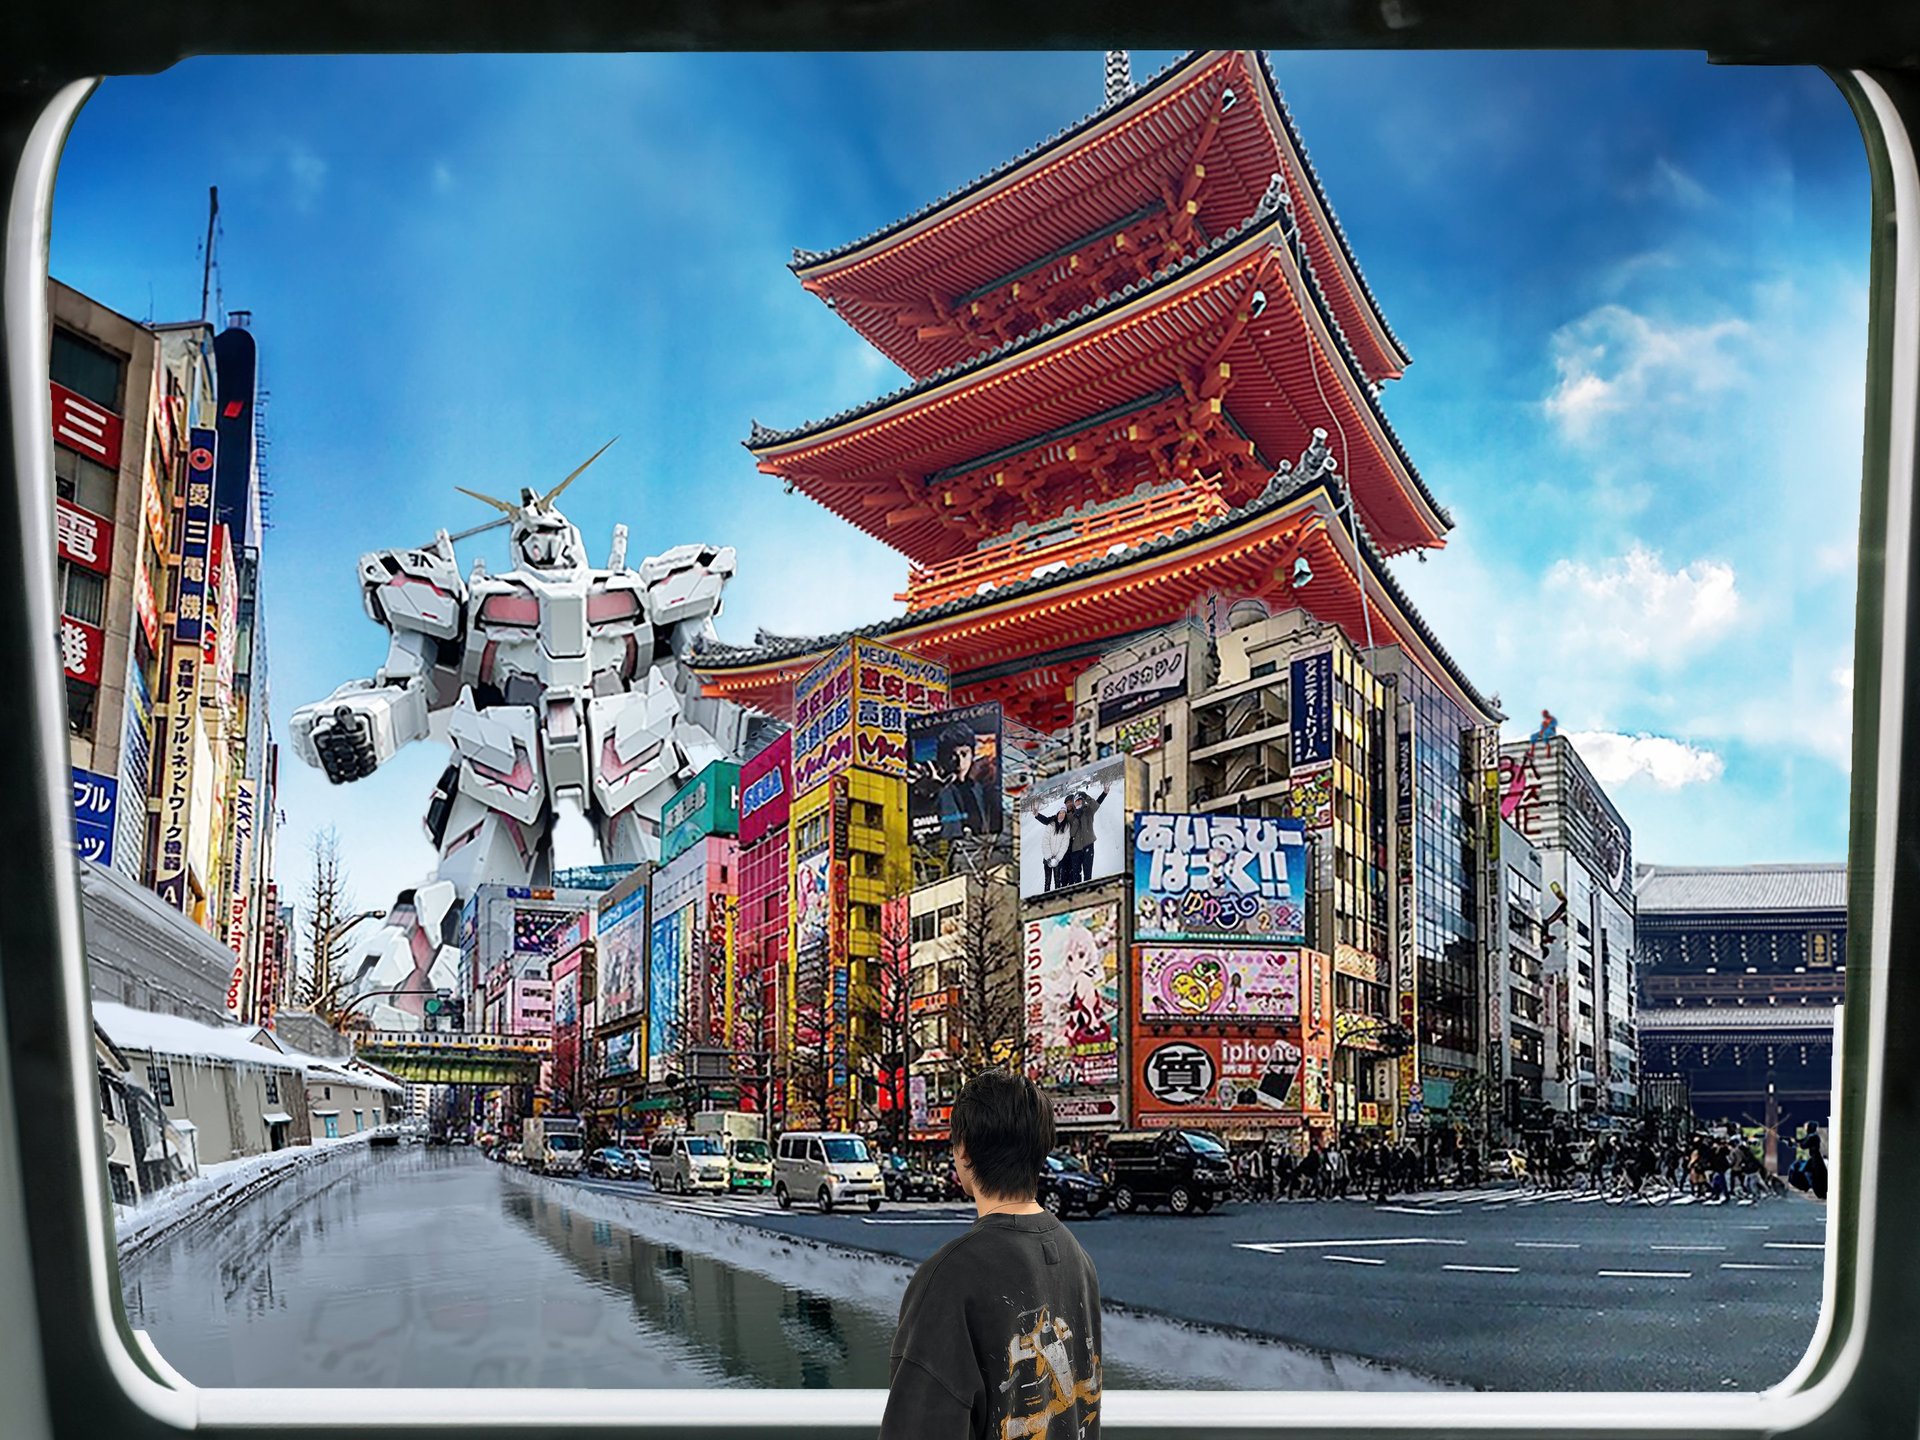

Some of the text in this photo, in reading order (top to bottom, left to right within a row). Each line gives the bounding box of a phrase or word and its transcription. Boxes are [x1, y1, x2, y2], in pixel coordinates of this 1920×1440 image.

[237, 784, 253, 840] AKKY
[742, 765, 785, 820] SEGA
[1136, 815, 1304, 853] あいるびー
[1152, 1050, 1208, 1097] 質
